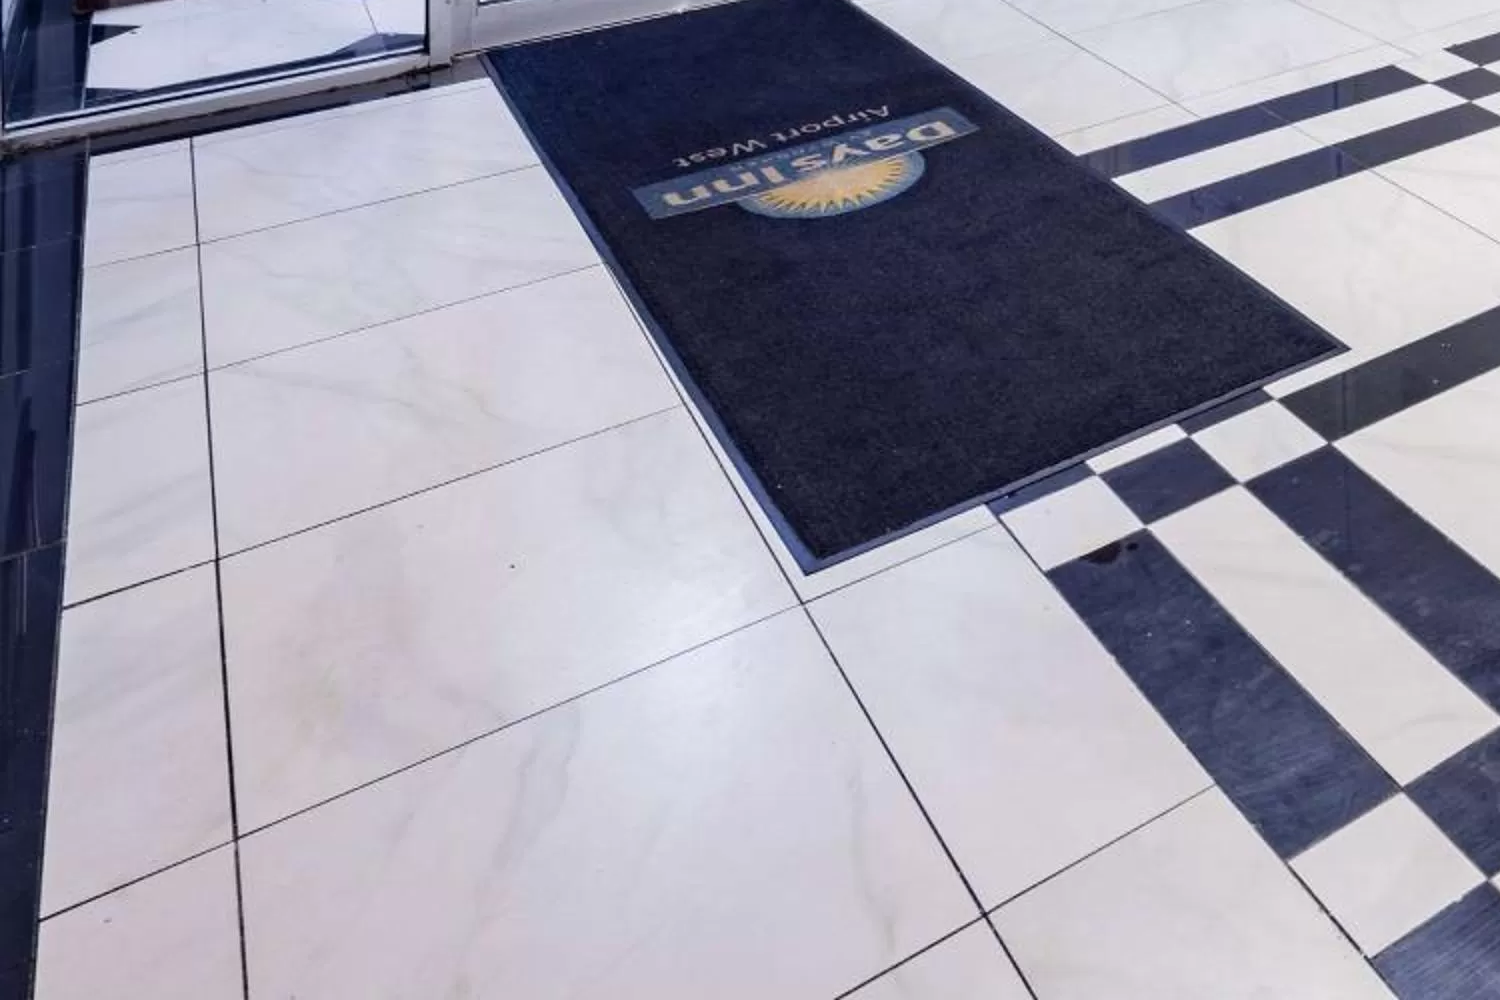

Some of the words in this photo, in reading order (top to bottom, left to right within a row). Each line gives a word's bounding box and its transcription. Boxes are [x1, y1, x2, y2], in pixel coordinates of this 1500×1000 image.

[771, 105, 889, 142] Airport
[673, 139, 768, 168] West
[791, 120, 954, 173] Days
[663, 166, 784, 206] Inn
